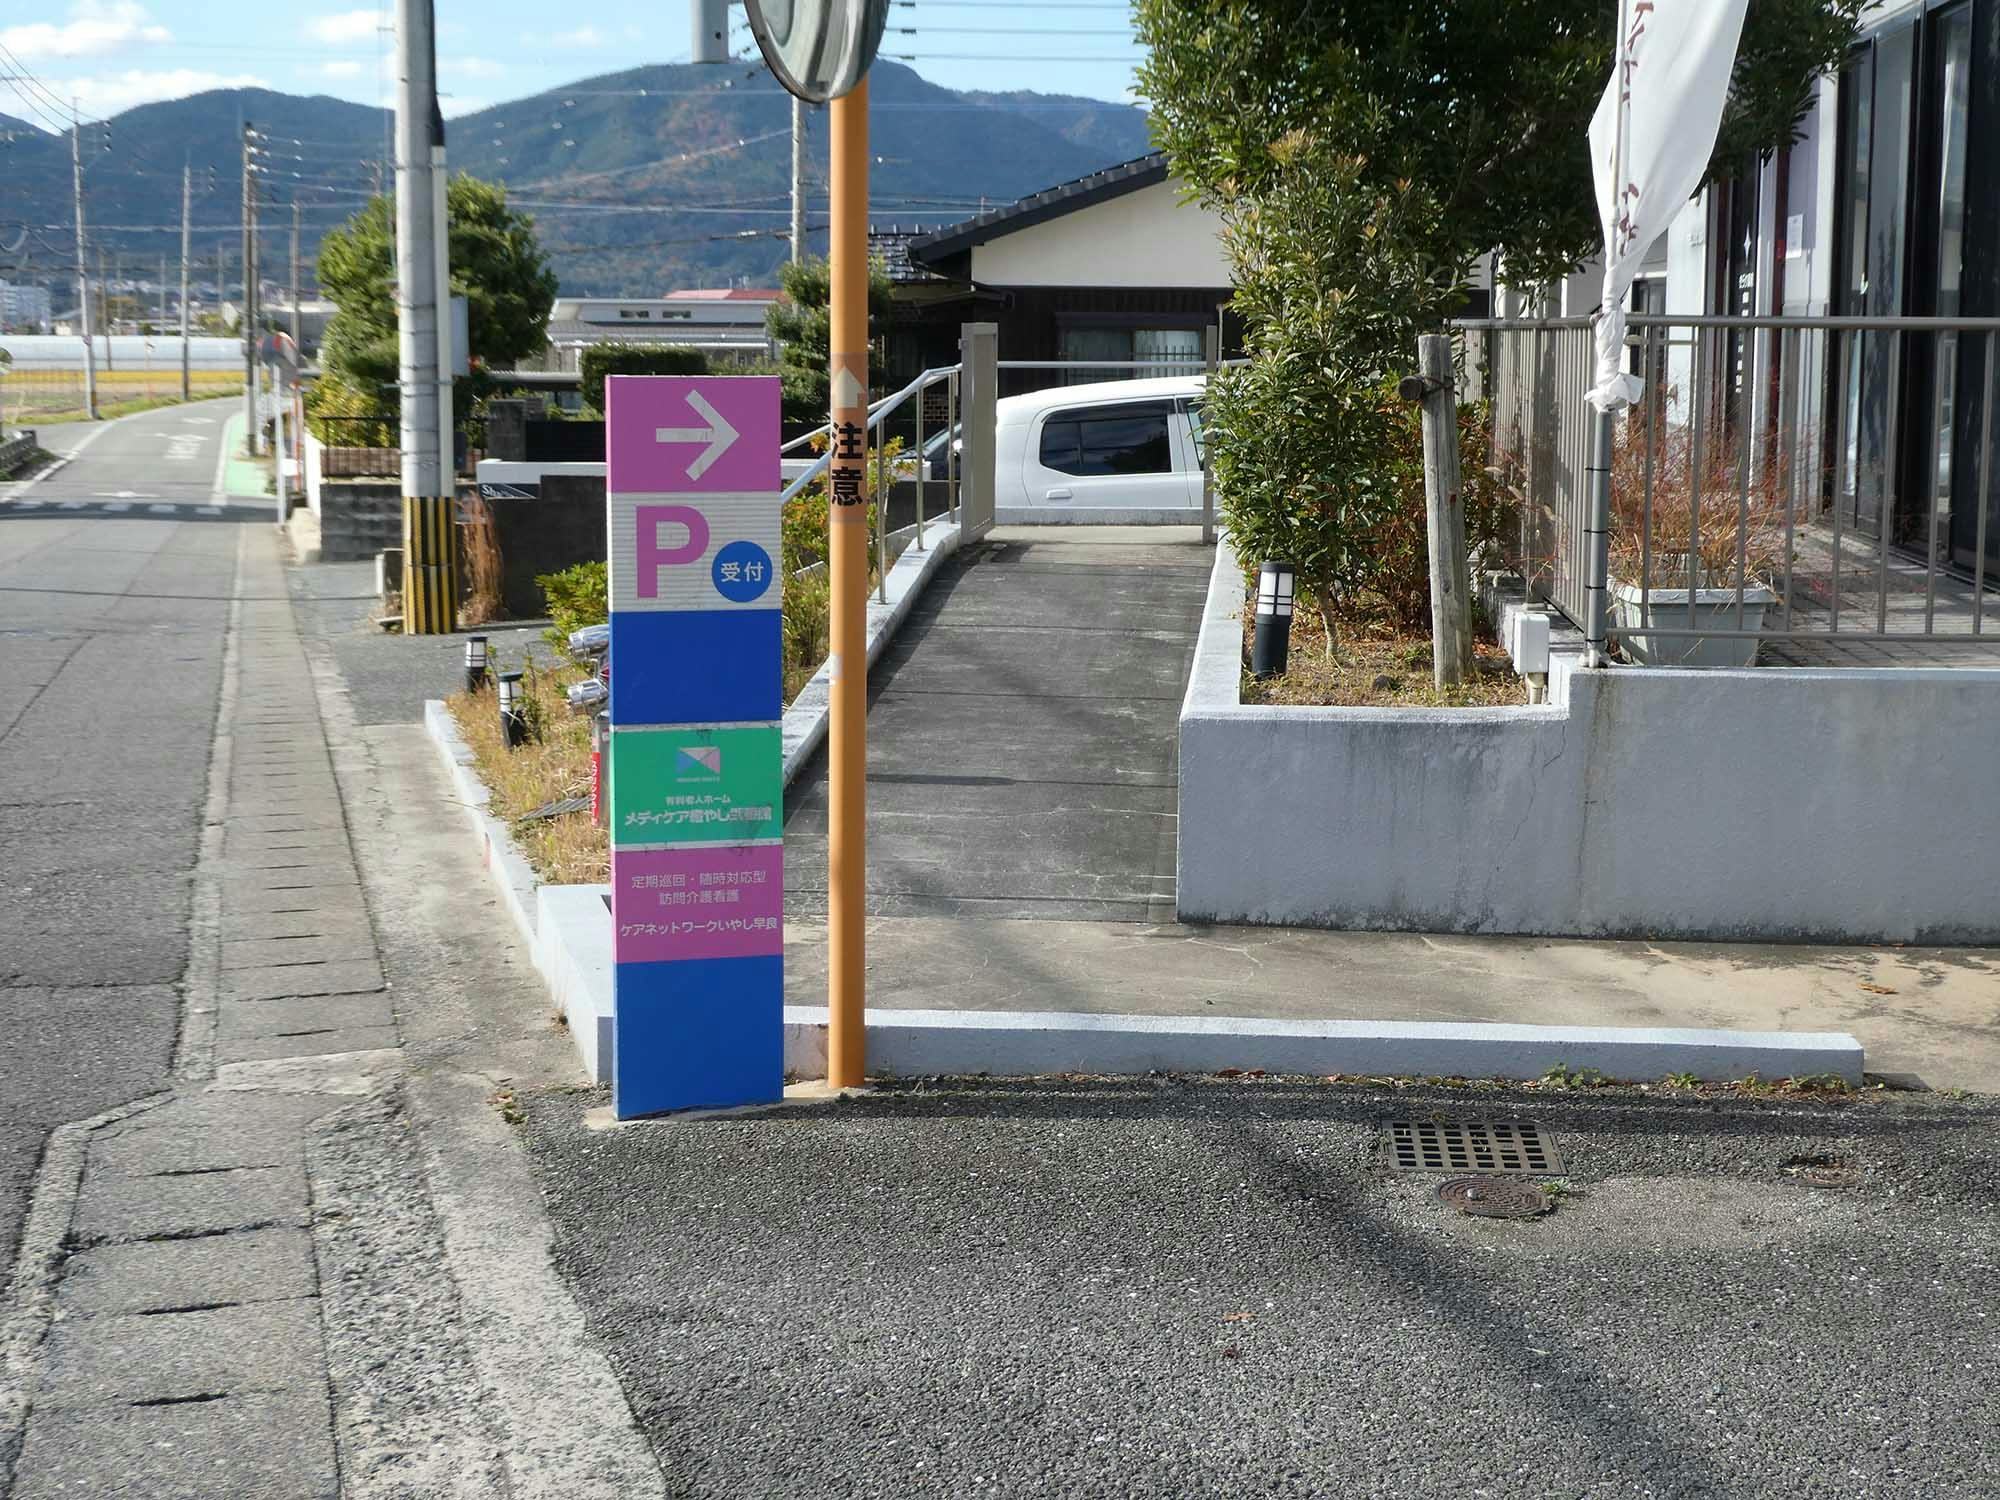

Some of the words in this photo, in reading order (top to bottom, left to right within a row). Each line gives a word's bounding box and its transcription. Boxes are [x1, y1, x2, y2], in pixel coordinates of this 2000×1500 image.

[830, 421, 863, 507] 注意
[635, 505, 710, 599] P
[719, 561, 765, 583] 受付
[631, 870, 767, 889] 定期巡回・随時対応型
[659, 889, 740, 905] 訪問介護看護
[620, 917, 778, 937] ケアネットワークいやし早良
